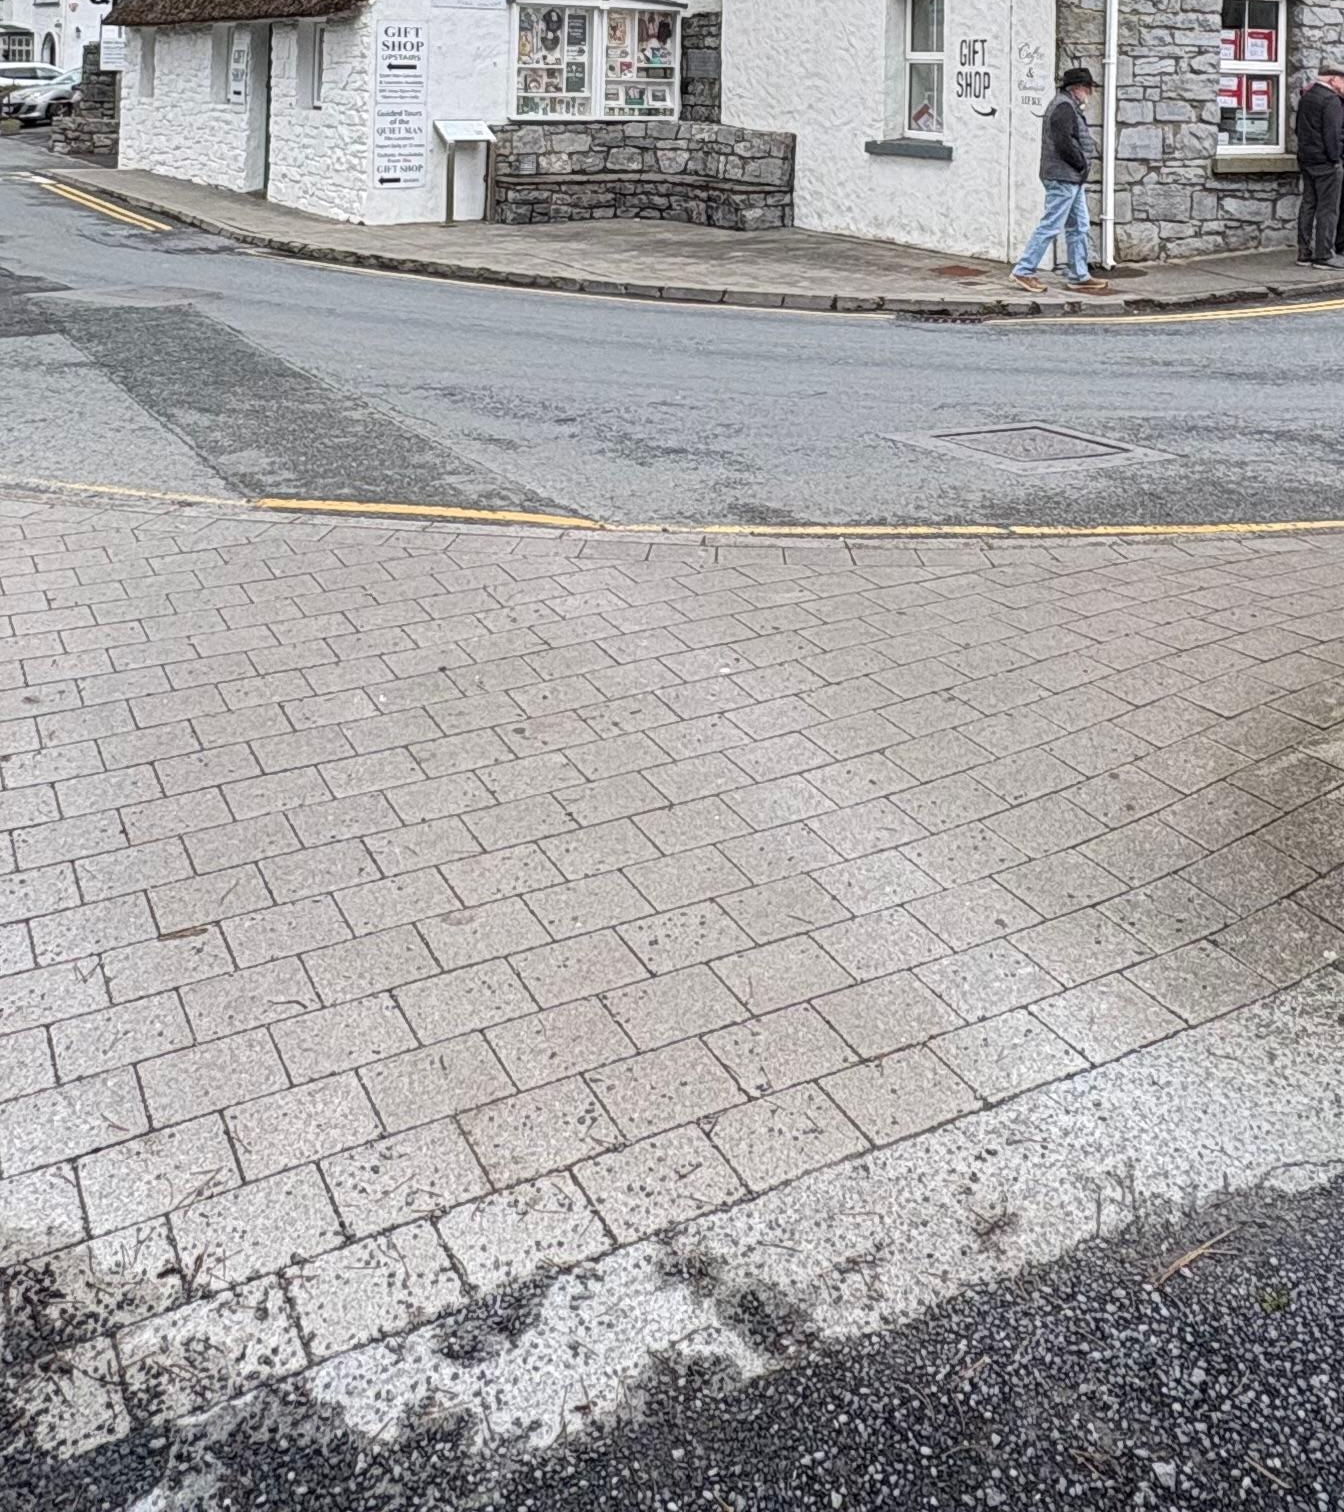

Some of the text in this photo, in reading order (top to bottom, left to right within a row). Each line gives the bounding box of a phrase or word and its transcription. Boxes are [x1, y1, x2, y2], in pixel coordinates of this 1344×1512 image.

[384, 25, 423, 38] GIFT
[381, 39, 424, 52] SHOP
[381, 53, 422, 62] UPSTAIRS
[959, 39, 988, 67] GIFT
[1026, 67, 1035, 79] &
[956, 70, 991, 100] SHOP
[376, 126, 423, 137] QUIET MAN
[376, 163, 424, 174] GIFT SHOP
